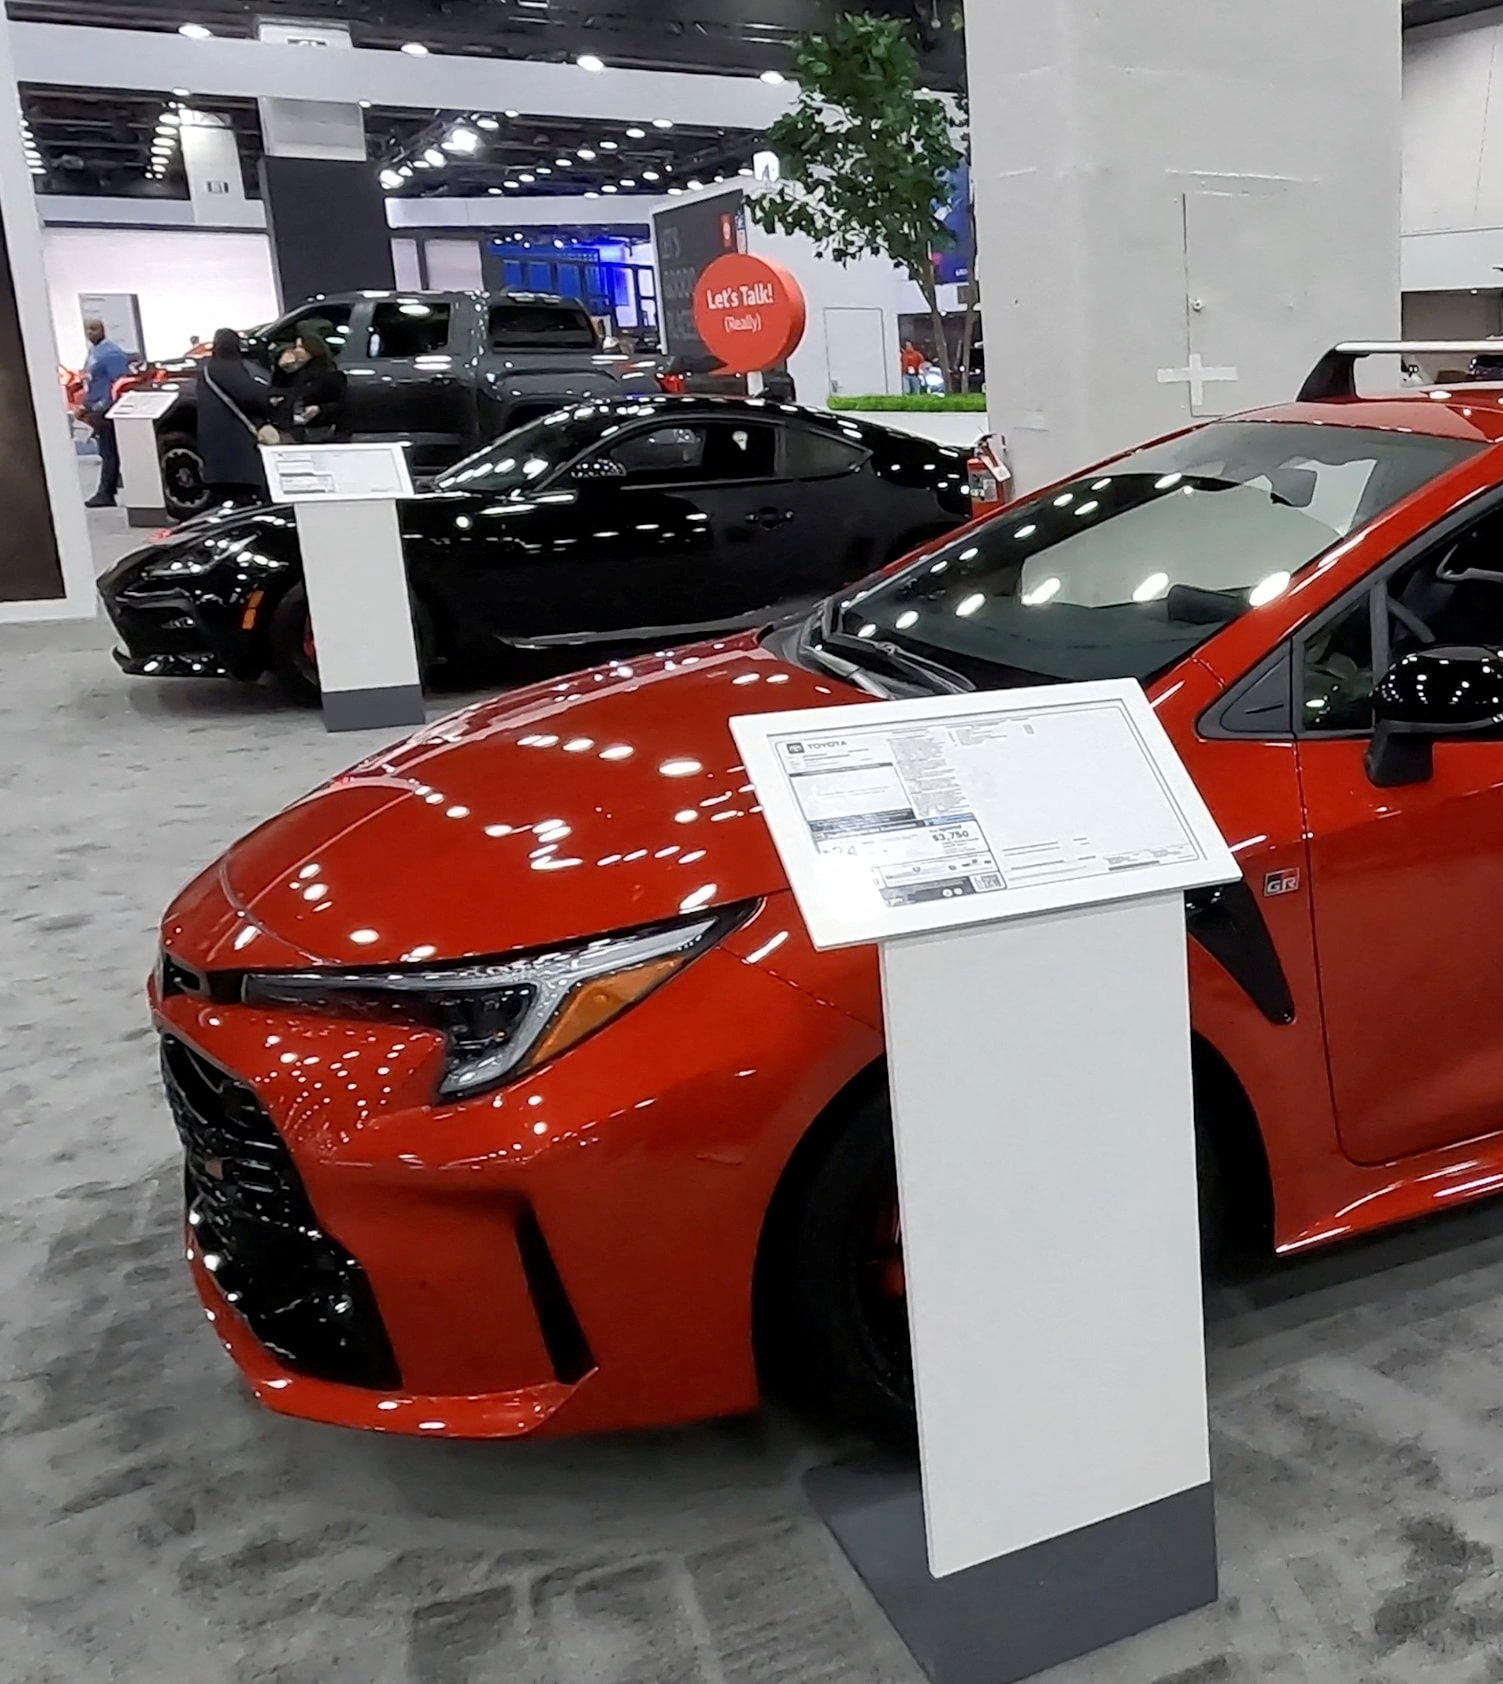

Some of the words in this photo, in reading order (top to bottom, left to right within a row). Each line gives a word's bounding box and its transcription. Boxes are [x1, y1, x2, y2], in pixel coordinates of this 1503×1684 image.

[707, 287, 739, 309] Let's
[739, 283, 774, 306] Talk!
[724, 313, 762, 333] (Really)
[807, 740, 848, 751] TOYOTA
[1267, 876, 1298, 893] GR
